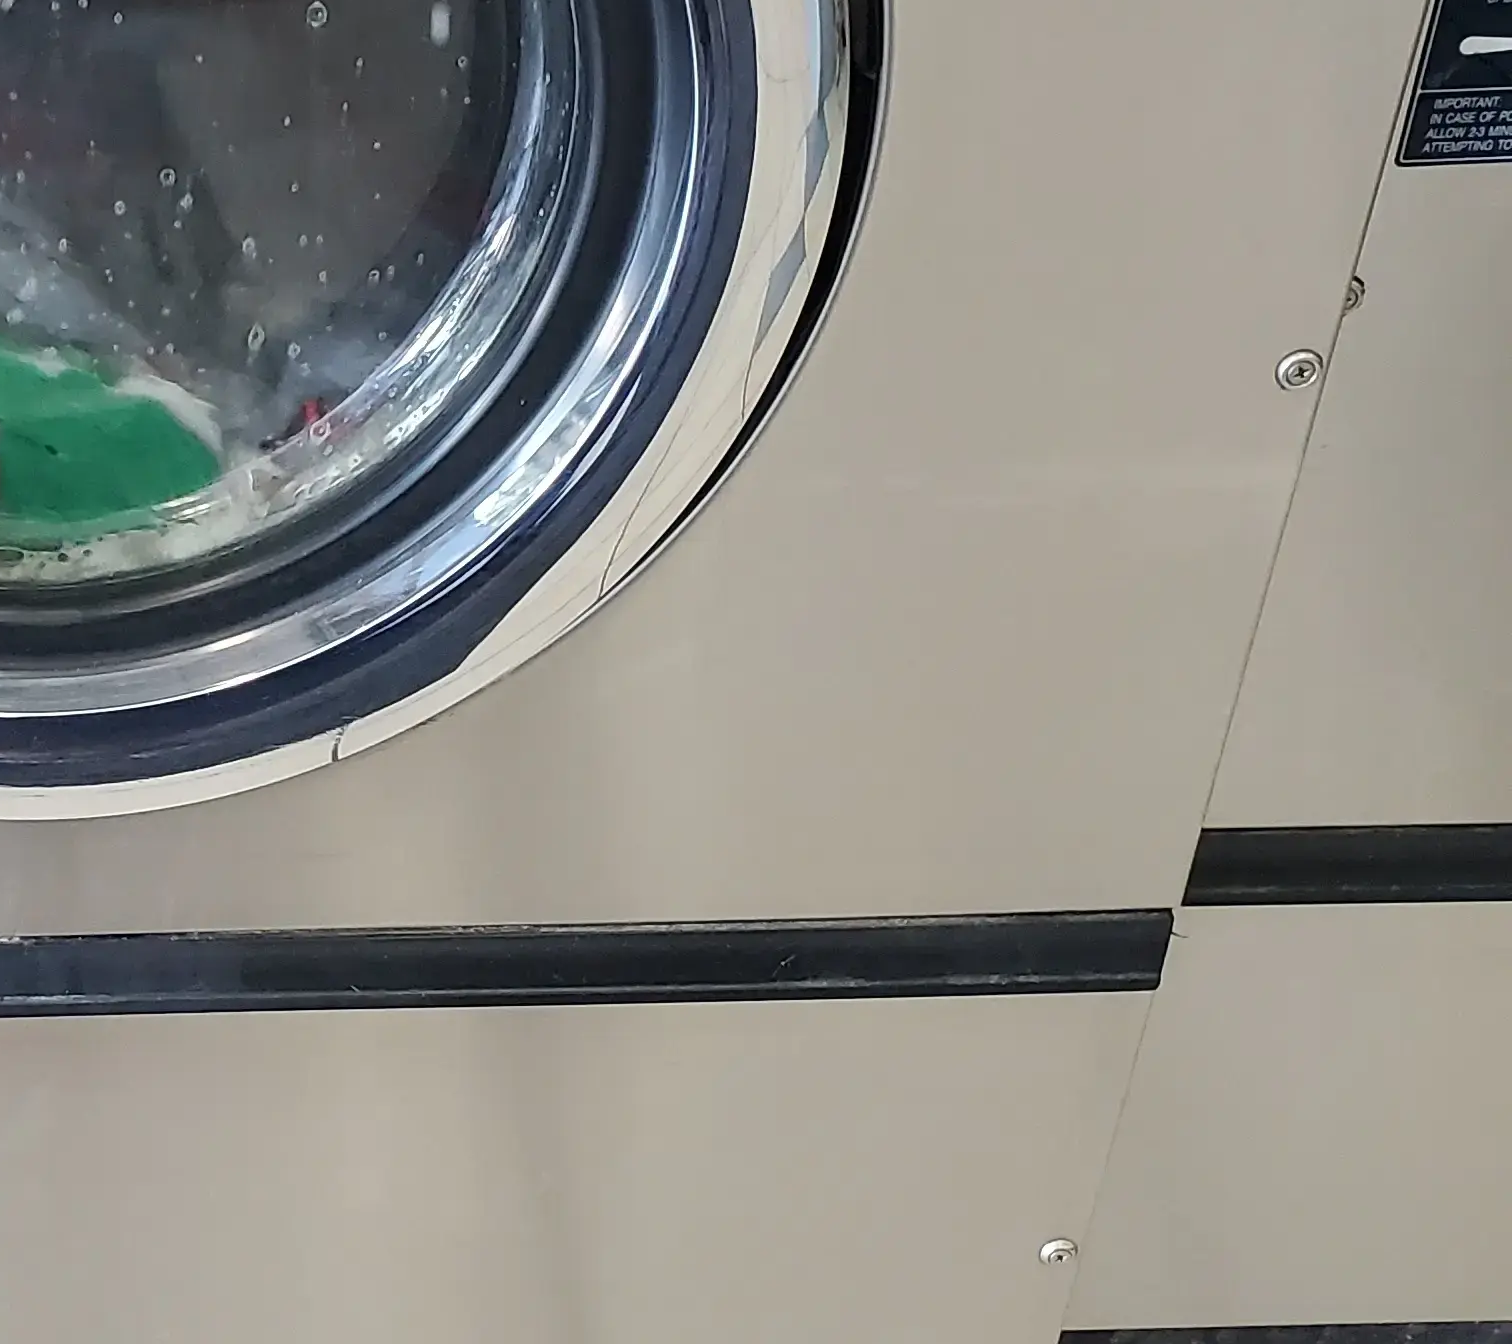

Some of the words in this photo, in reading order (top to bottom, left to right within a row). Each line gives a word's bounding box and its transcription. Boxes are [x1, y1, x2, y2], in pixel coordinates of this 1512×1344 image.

[1429, 113, 1443, 125] IN
[1444, 110, 1477, 125] CASE
[1479, 110, 1497, 123] OF
[1423, 126, 1467, 140] ALLOW
[1467, 125, 1486, 138] 2-3
[1420, 139, 1495, 154] ATTEMPTING
